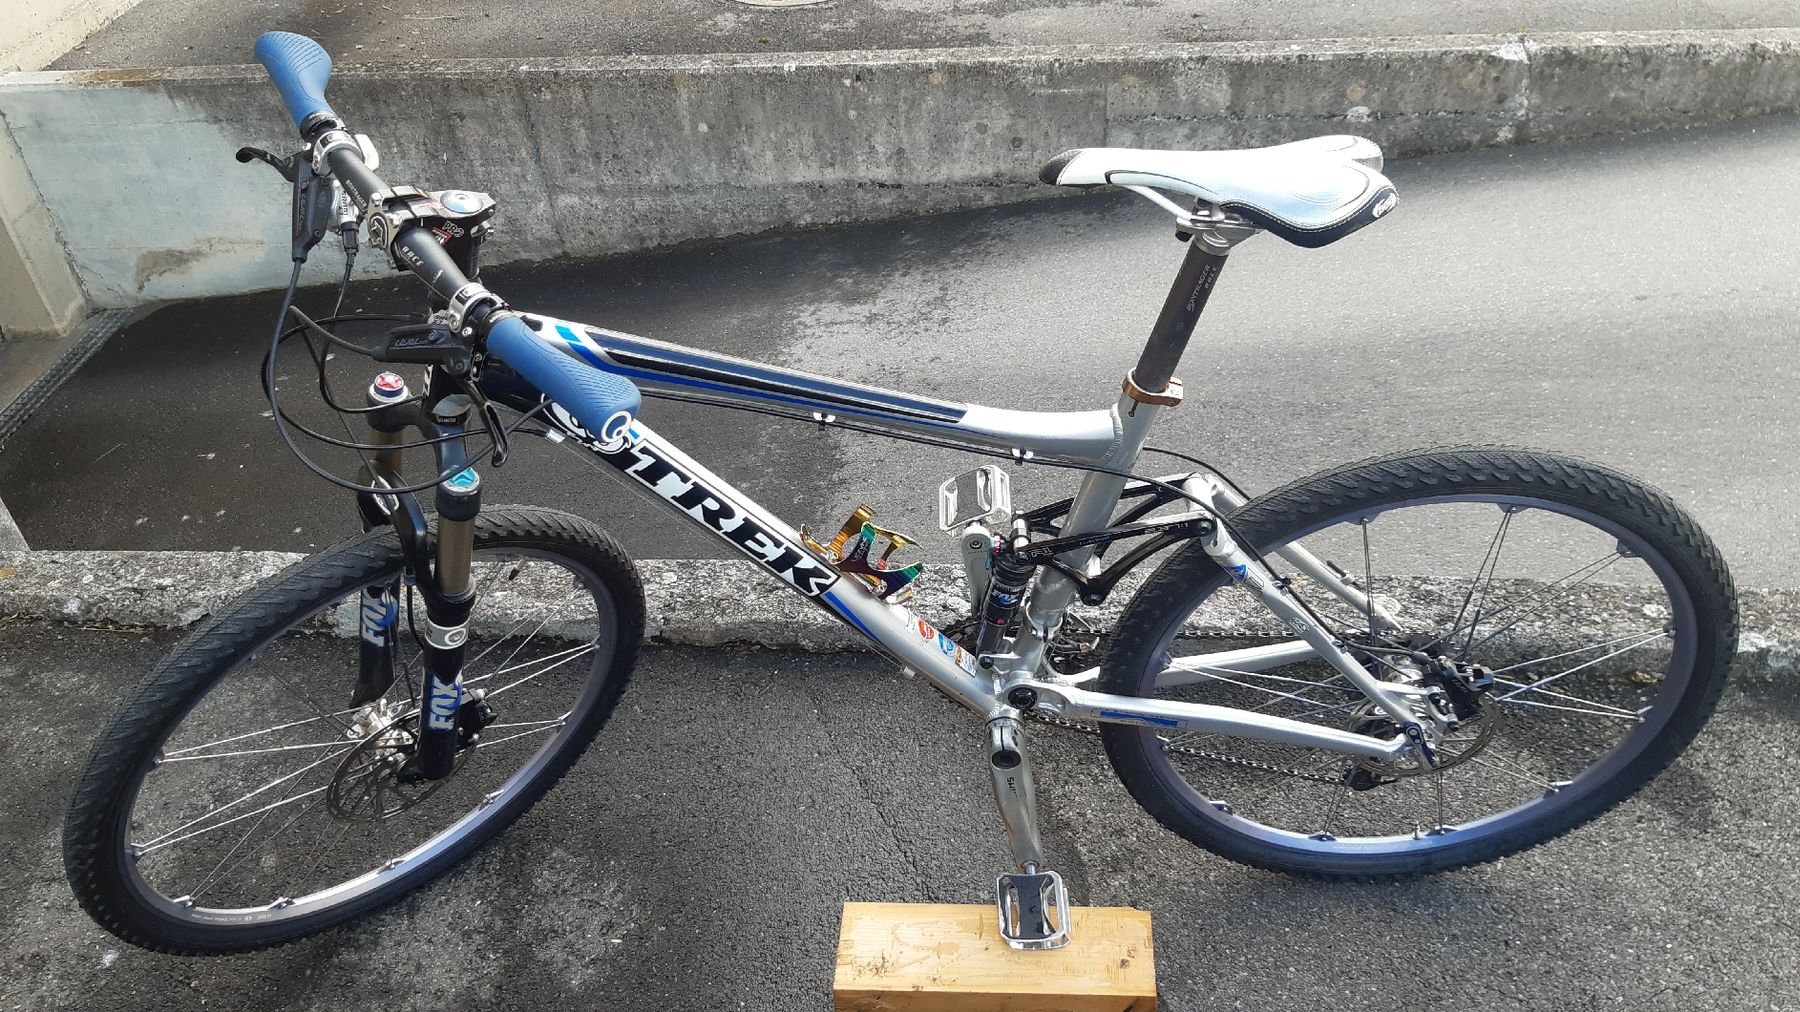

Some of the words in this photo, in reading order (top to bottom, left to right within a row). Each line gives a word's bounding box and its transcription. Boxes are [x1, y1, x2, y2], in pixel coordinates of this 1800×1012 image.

[401, 246, 424, 267] RACE
[1186, 264, 1211, 312] BONTRAGER
[632, 445, 833, 595] TREK
[361, 588, 388, 648] FOX
[428, 673, 460, 731] FOX
